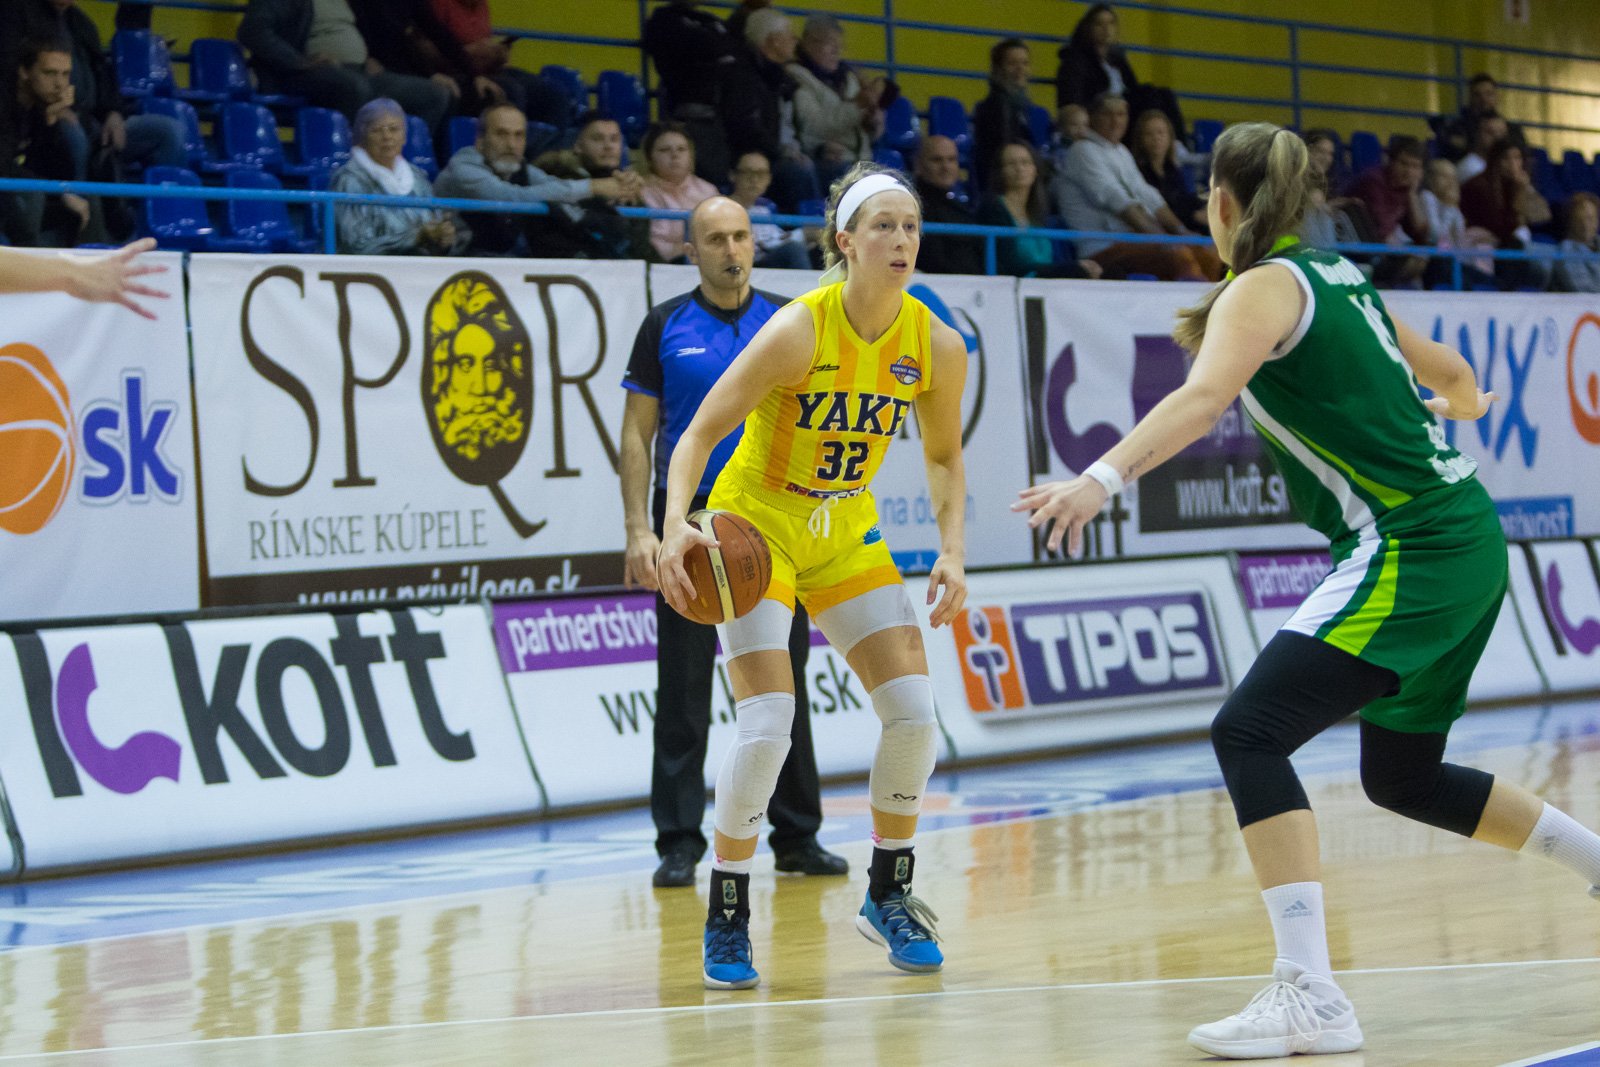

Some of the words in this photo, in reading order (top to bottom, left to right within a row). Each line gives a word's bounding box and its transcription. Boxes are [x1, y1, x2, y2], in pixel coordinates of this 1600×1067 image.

[240, 264, 621, 539] SPQR
[815, 439, 871, 483] 32
[248, 509, 364, 560] RÍMSKE
[374, 502, 488, 553] KÚPELE
[743, 555, 756, 581] FIBA
[1022, 602, 1210, 693] TIPOS
[160, 608, 477, 786] koft
